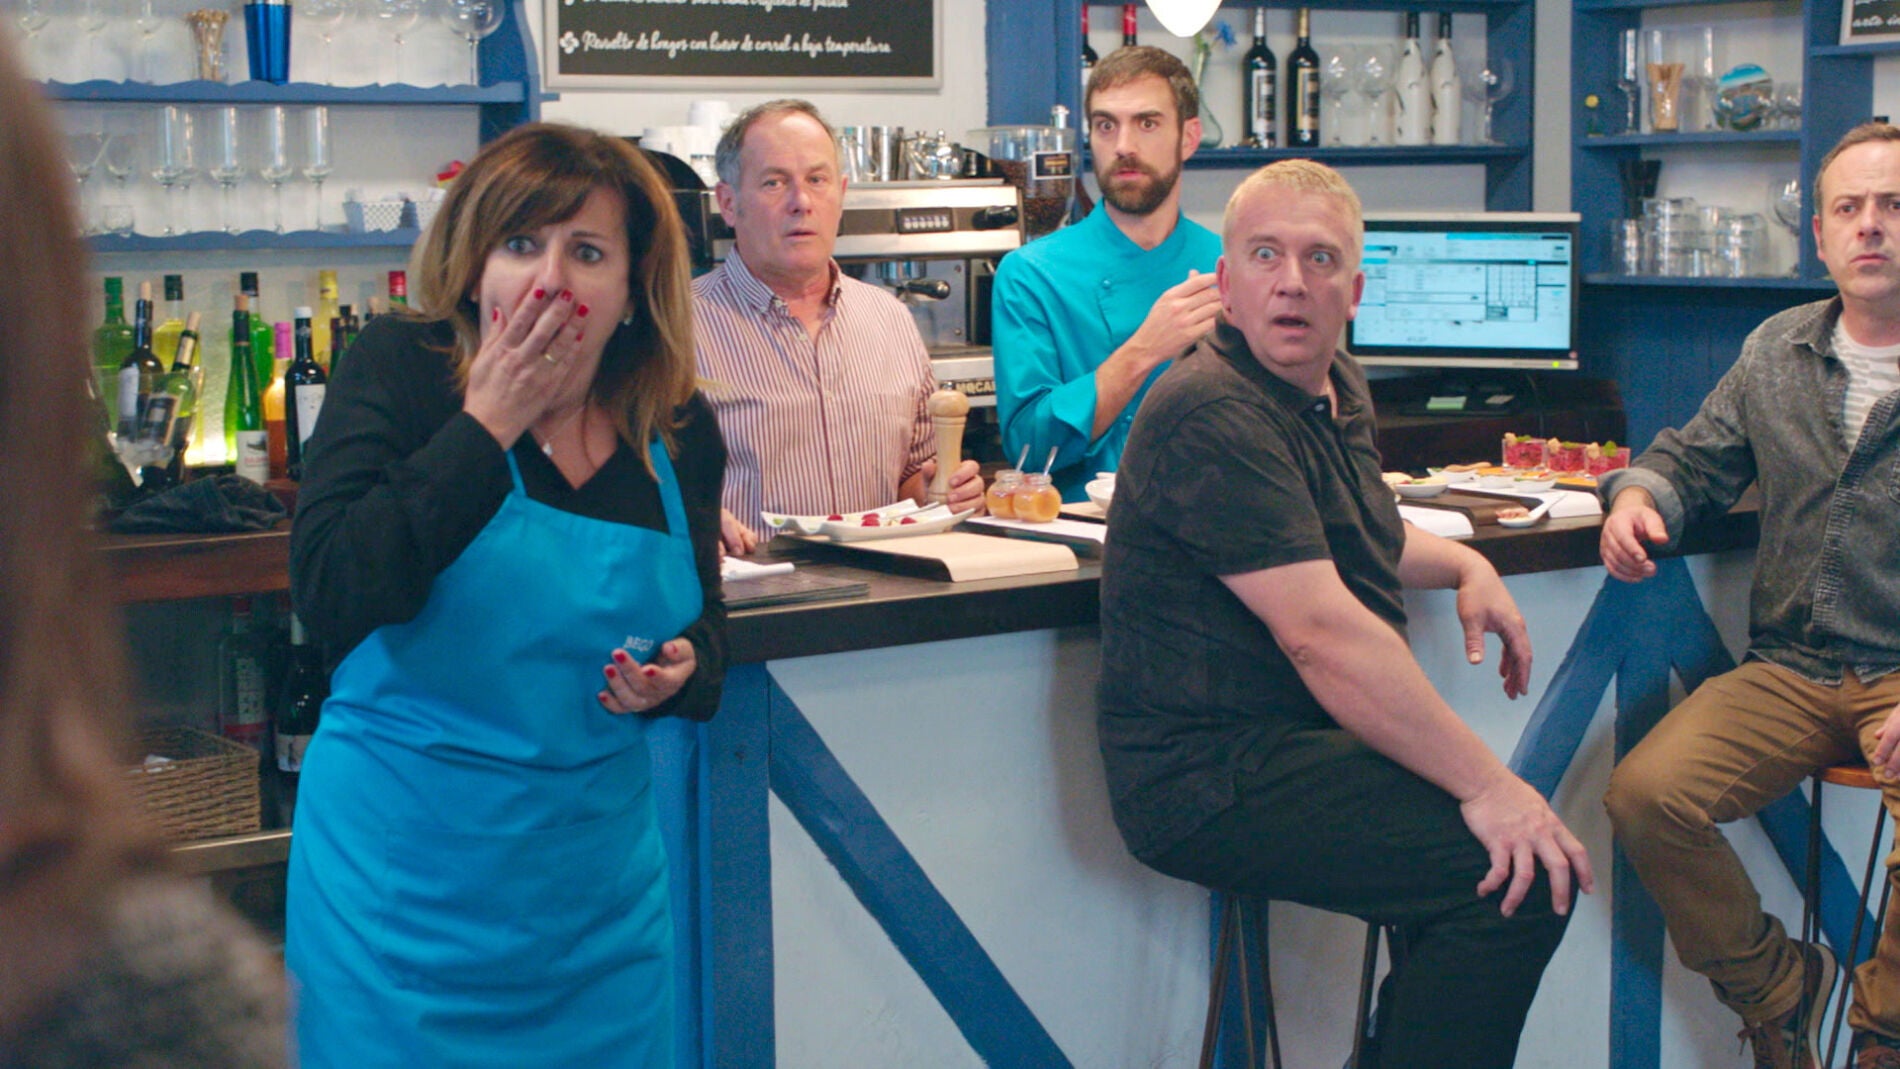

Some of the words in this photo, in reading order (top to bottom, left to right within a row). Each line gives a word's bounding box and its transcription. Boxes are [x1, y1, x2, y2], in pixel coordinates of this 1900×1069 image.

[635, 32, 649, 51] de
[650, 30, 688, 59] hongos
[689, 38, 708, 51] con
[740, 33, 753, 52] de
[754, 33, 791, 52] corral
